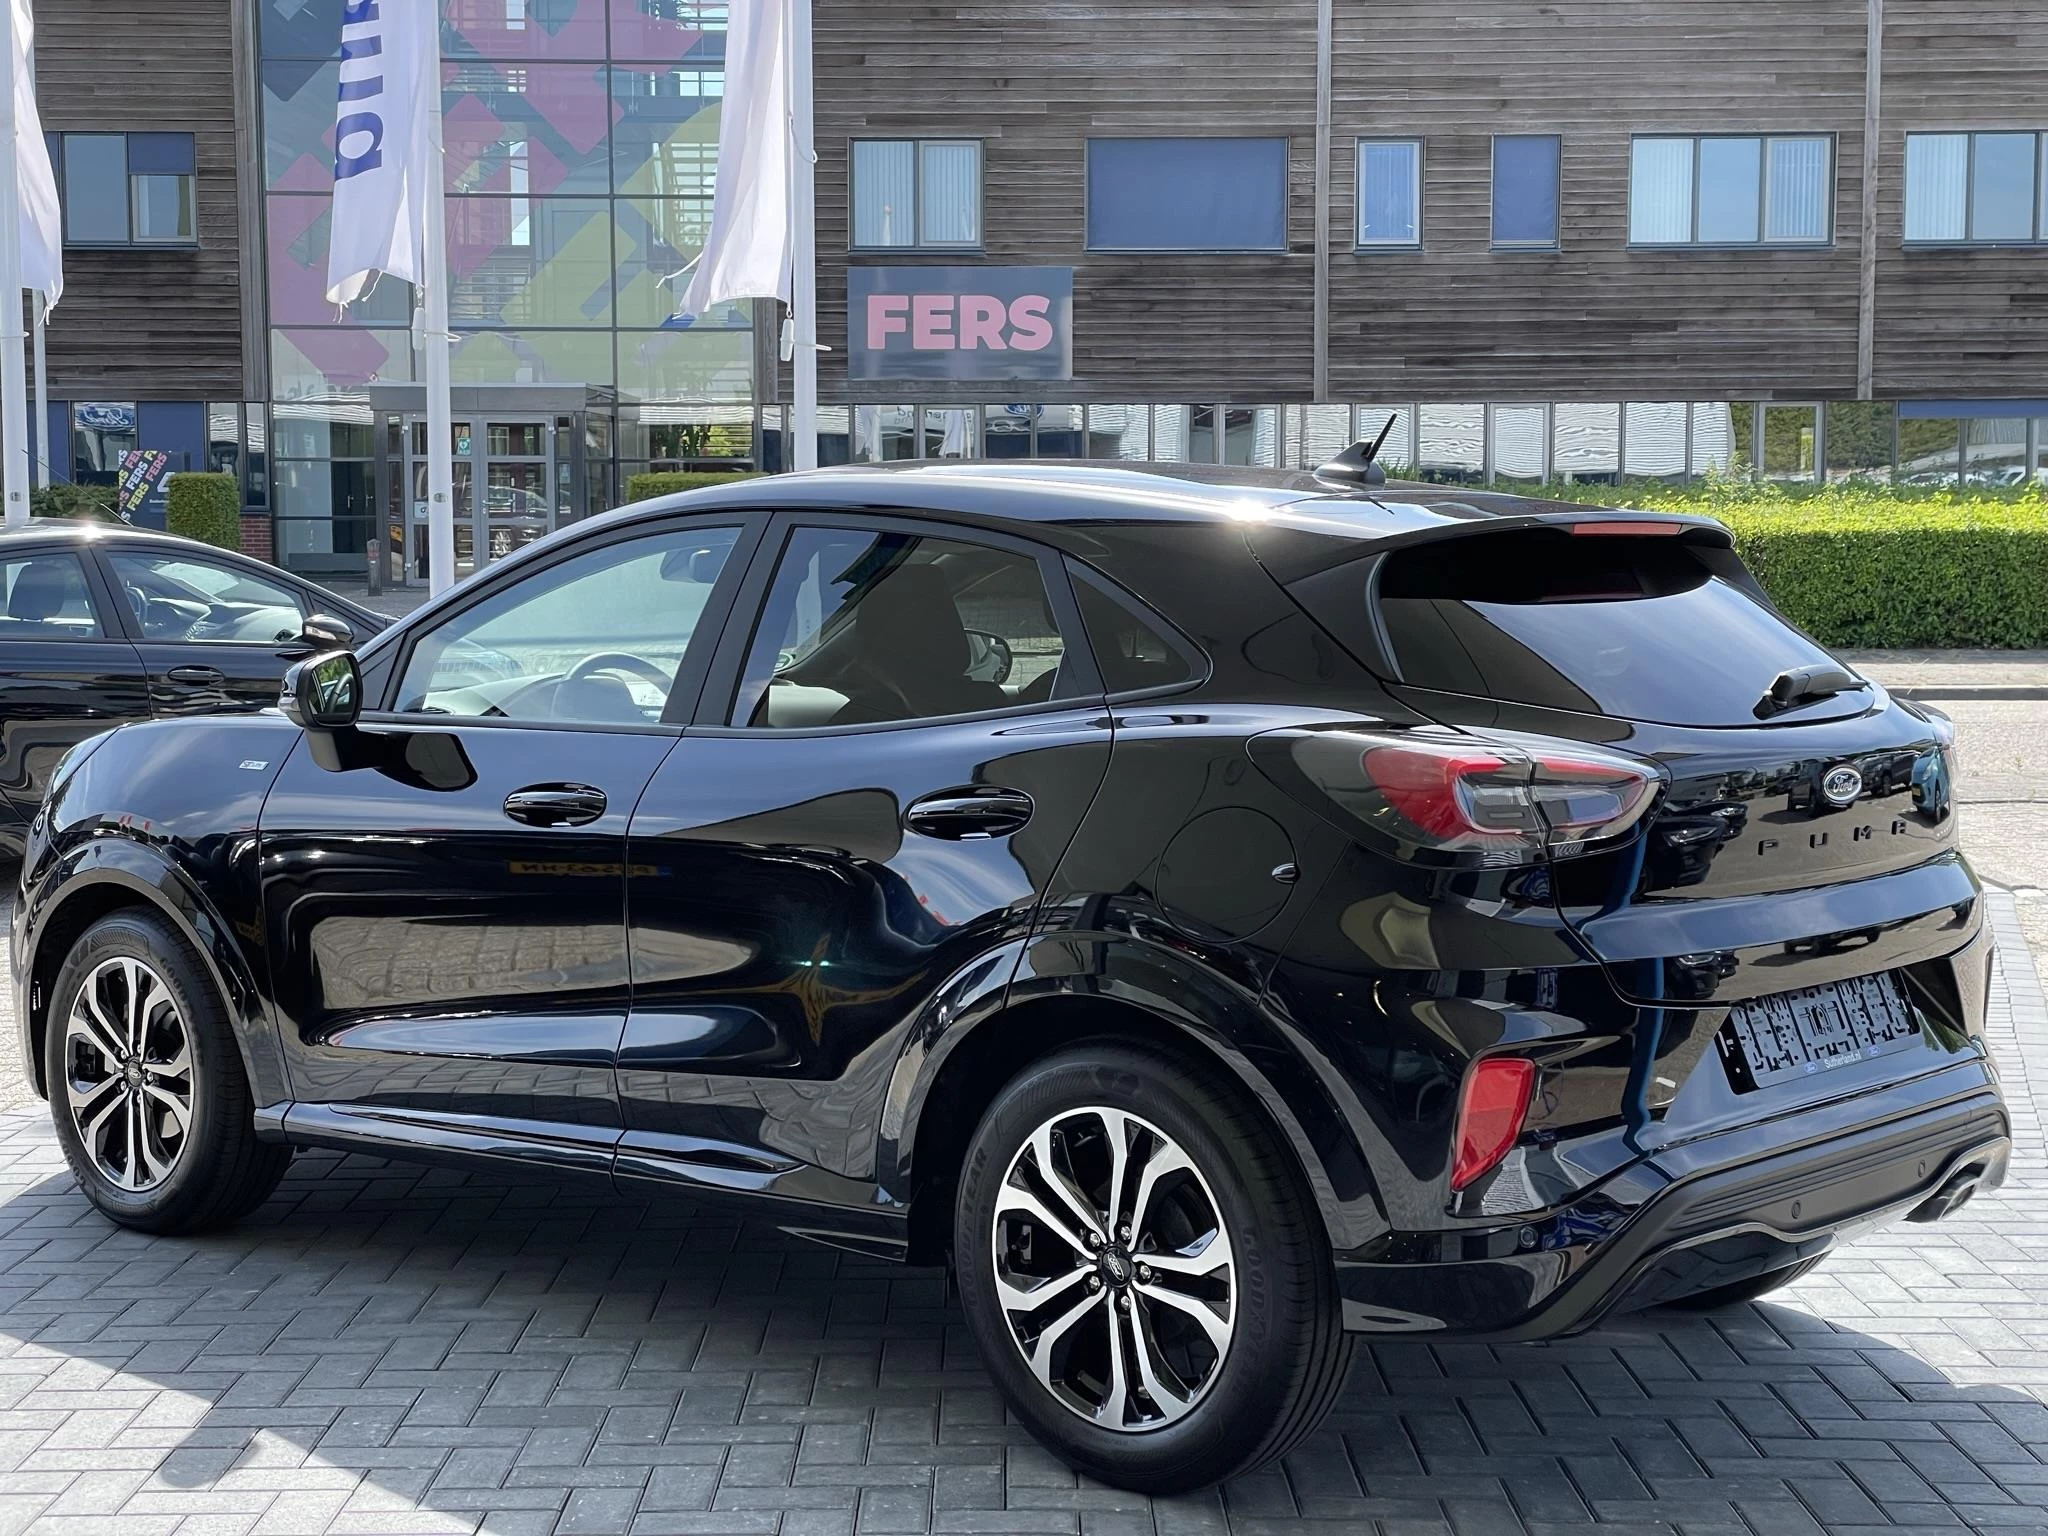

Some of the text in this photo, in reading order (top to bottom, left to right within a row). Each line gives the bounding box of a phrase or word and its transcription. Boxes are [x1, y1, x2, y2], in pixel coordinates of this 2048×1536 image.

[867, 294, 1053, 351] FERS
[125, 461, 148, 490] FERS
[145, 452, 168, 482] FERS
[126, 482, 149, 511] FERS
[1833, 773, 1855, 793] Ford
[1757, 820, 1907, 855] PUMA
